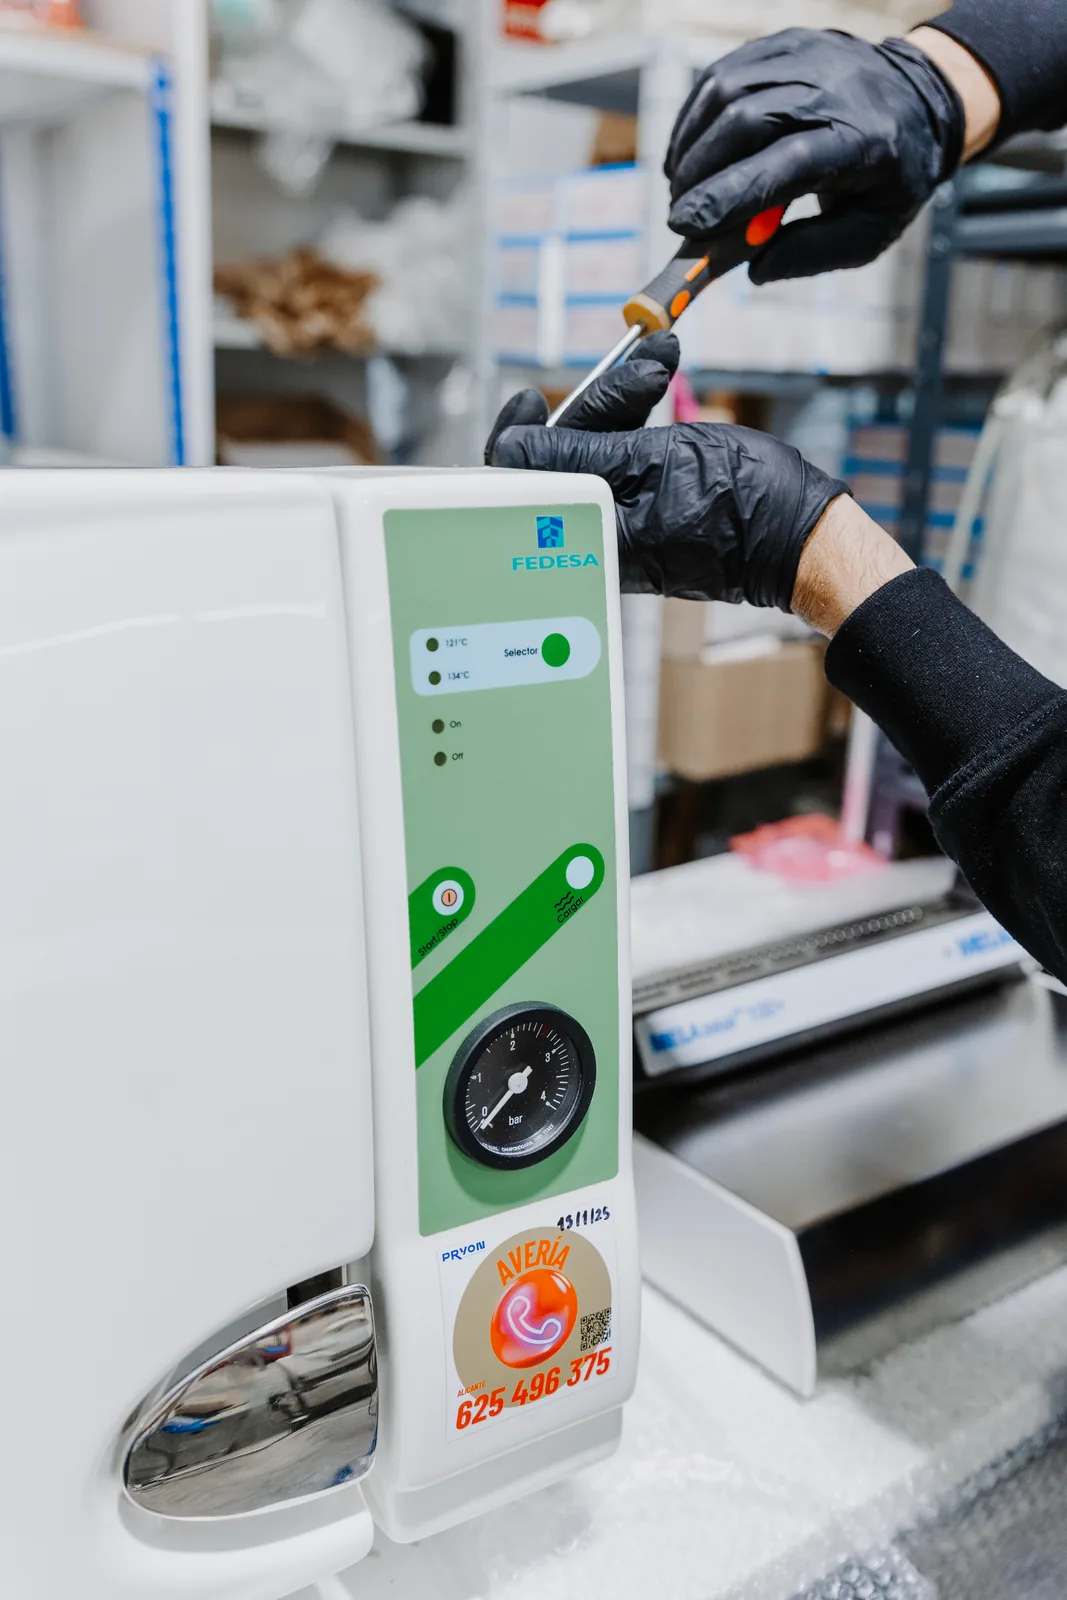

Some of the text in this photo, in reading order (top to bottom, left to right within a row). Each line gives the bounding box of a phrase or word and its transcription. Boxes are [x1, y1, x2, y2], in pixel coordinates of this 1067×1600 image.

[512, 553, 599, 571] FEDESA
[504, 646, 538, 658] Selector
[450, 719, 462, 730] On
[451, 751, 464, 761] Off
[557, 896, 584, 923] Cargar
[417, 917, 459, 957] Start/Stop
[510, 1040, 516, 1052] 2
[545, 1052, 551, 1063] 3
[478, 1072, 482, 1083] 1
[540, 1090, 547, 1101] 4
[481, 1106, 488, 1117] 0
[508, 1114, 524, 1127] bar
[442, 1240, 486, 1262] PRYON
[496, 1235, 571, 1287] AVERÍA
[455, 1347, 612, 1430] 625 496 375
[457, 1379, 487, 1398] ALICANTE
